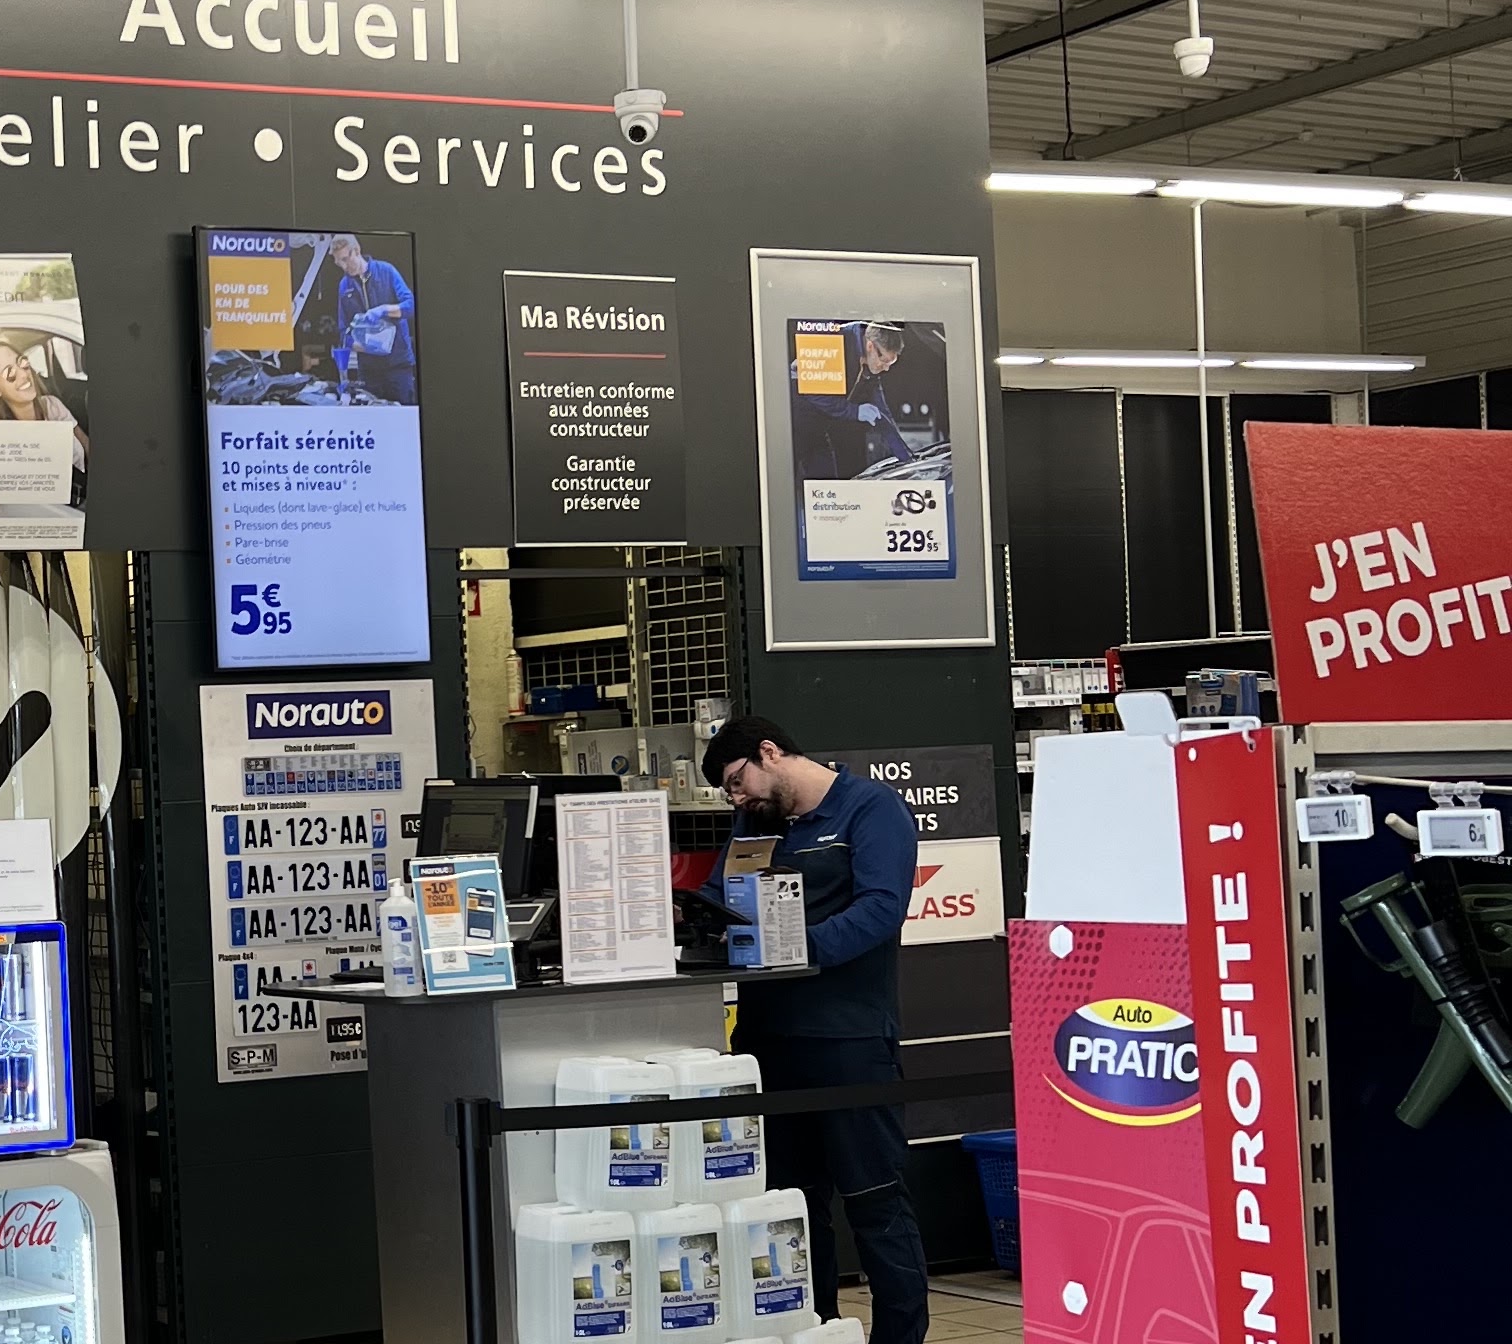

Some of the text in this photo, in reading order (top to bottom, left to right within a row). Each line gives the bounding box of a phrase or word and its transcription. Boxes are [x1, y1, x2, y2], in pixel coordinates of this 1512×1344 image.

[335, 115, 668, 196] Services
[213, 235, 285, 252] Norauto
[215, 284, 268, 295] POUR DES
[216, 298, 249, 308] KM DE
[520, 305, 665, 331] Ma Révision
[797, 322, 840, 332] Norauto
[800, 349, 838, 357] FORFAIT
[800, 360, 825, 369] TOUT
[800, 372, 842, 381] COMPRIS
[520, 381, 675, 399] Entretien conforme
[549, 401, 649, 418] aux données
[550, 422, 649, 436] constructeur
[221, 430, 375, 449] Forfait sérénité
[223, 459, 371, 477] 10 points de contrôle
[567, 455, 635, 472] Garantie
[223, 480, 236, 491] et
[242, 478, 279, 491] mises
[285, 477, 291, 491] à
[552, 476, 651, 491] constructeur
[564, 494, 640, 513] préservée
[235, 521, 331, 532] Pression des pneus
[235, 538, 289, 547] Pare-brise
[886, 530, 925, 552] 329
[236, 555, 291, 564] Géométrie
[1310, 522, 1436, 602] J'EN
[231, 584, 260, 634] 5
[1305, 575, 1512, 678] PROFIT
[255, 699, 384, 727] Norauto
[870, 761, 912, 781] NOS
[374, 873, 385, 886] 01
[239, 1000, 317, 1033] 123-AA
[1113, 1005, 1152, 1025] Auto
[1212, 872, 1273, 1244] PROFITE
